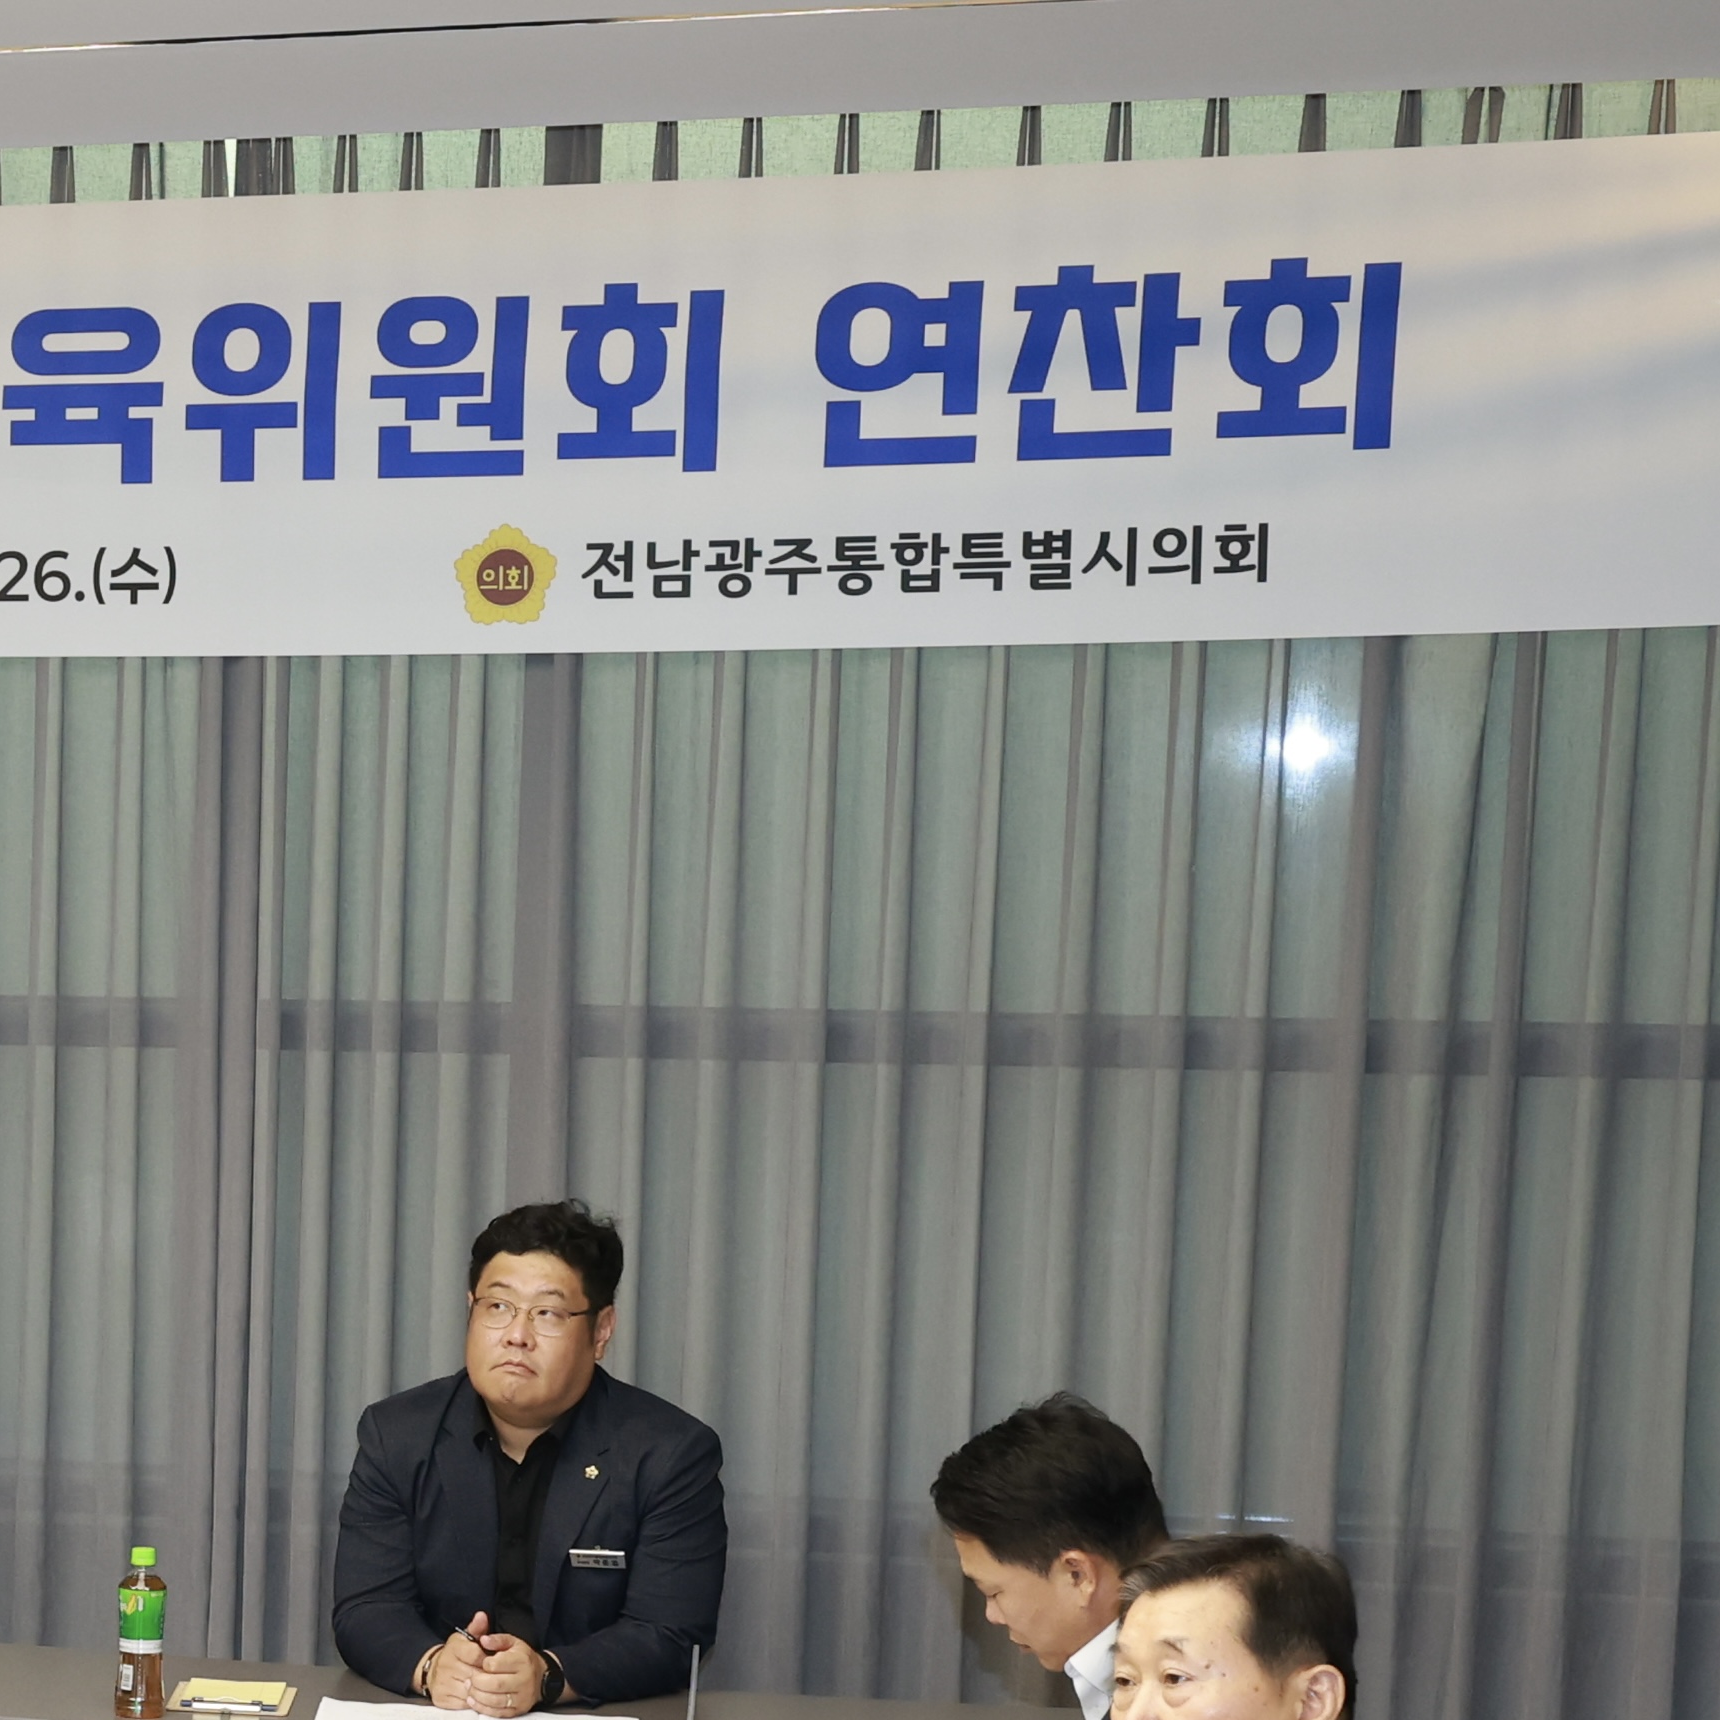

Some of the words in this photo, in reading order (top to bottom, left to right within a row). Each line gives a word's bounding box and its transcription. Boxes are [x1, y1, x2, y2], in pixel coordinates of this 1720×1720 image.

[817, 259, 1401, 468] 연찬회
[479, 564, 529, 591] 의회
[581, 522, 1270, 601] 전남광주통합특별시의회
